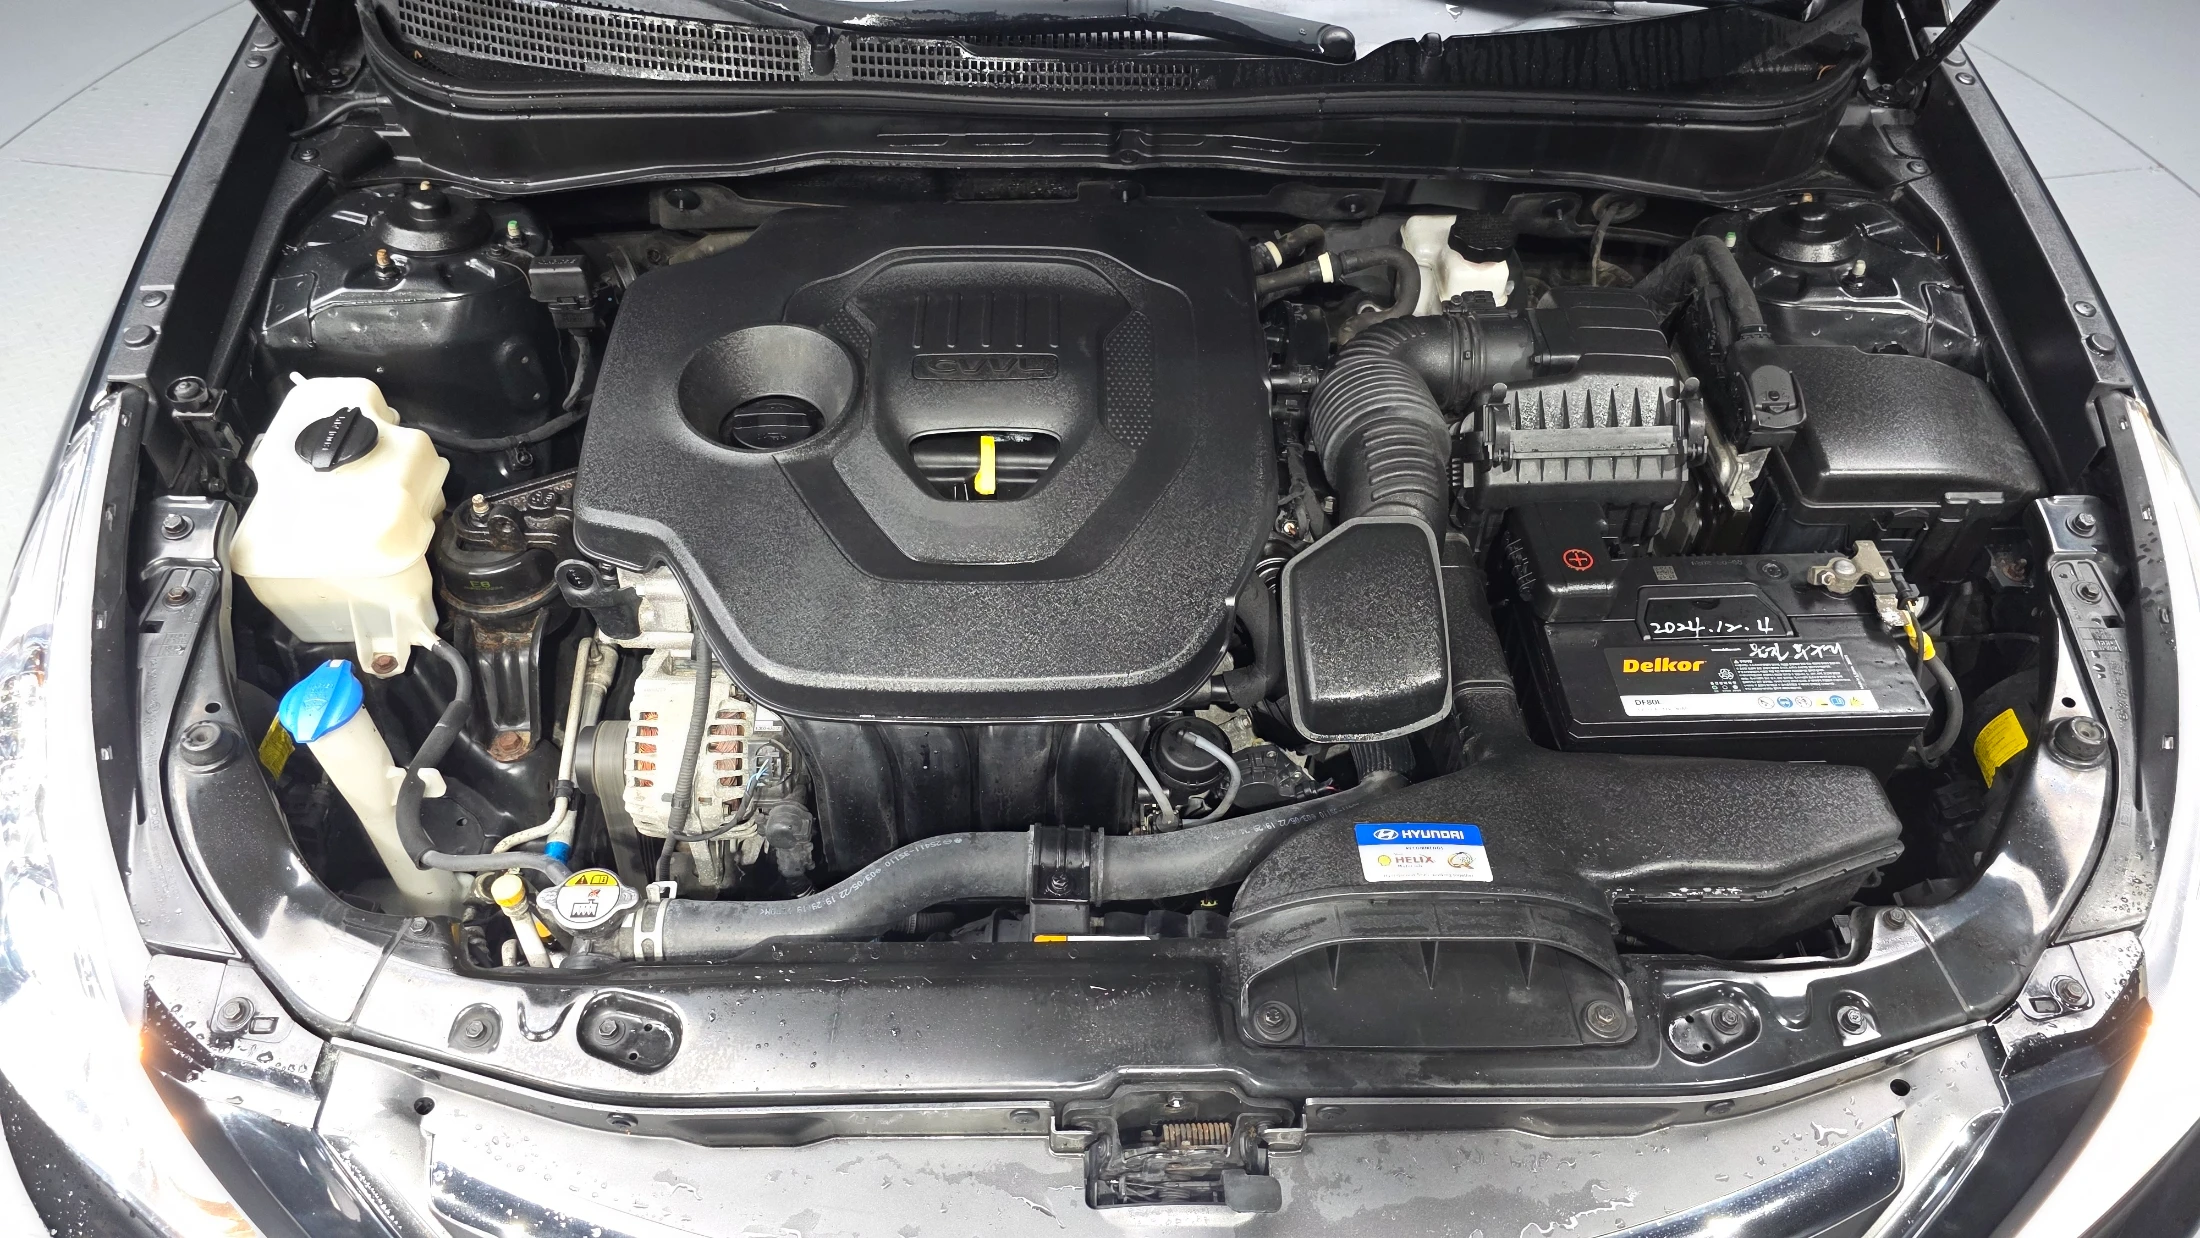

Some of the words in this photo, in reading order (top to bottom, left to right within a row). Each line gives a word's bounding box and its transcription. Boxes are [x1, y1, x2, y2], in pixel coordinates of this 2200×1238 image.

[1622, 657, 1704, 673] Delkor
[1401, 829, 1465, 840] HYUNDAI
[1395, 855, 1434, 864] HELIX
[839, 871, 876, 899] 03/05/22
